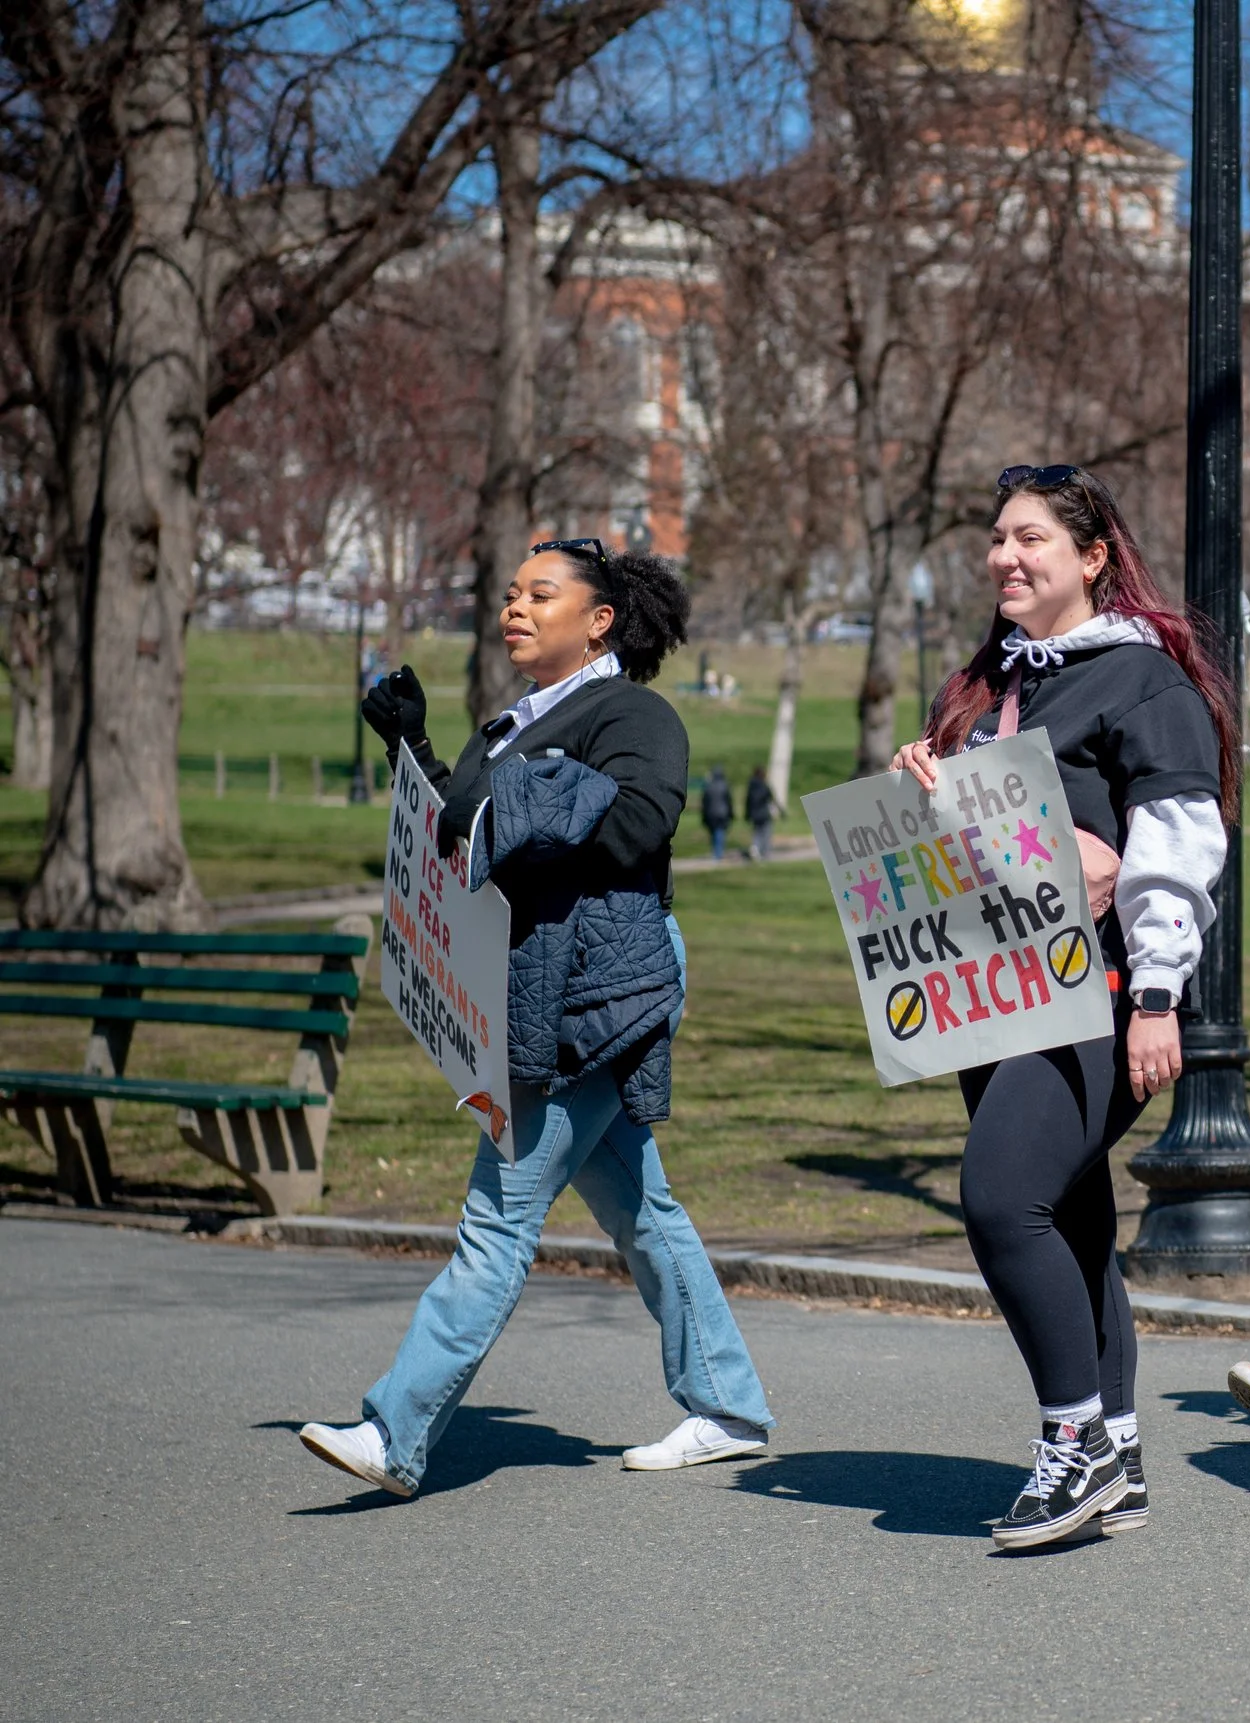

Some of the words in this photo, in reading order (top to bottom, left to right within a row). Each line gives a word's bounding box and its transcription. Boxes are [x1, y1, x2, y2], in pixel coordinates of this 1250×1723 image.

[394, 804, 413, 858] NO
[422, 845, 443, 903] ICE
[400, 759, 419, 814] NO
[425, 800, 467, 889] KGS
[823, 799, 900, 866] Land
[901, 788, 939, 837] of
[955, 772, 1028, 824] the
[881, 825, 998, 912] FREE
[390, 847, 410, 899] NO
[418, 890, 451, 958] FEAR
[857, 910, 963, 981] FUCK
[979, 881, 1065, 945] the
[382, 918, 406, 977] ARE
[412, 959, 476, 1077] WELCOME
[389, 890, 489, 1049] IMMIGRANTS
[924, 944, 1052, 1035] RICH
[399, 984, 443, 1068] HERE!
